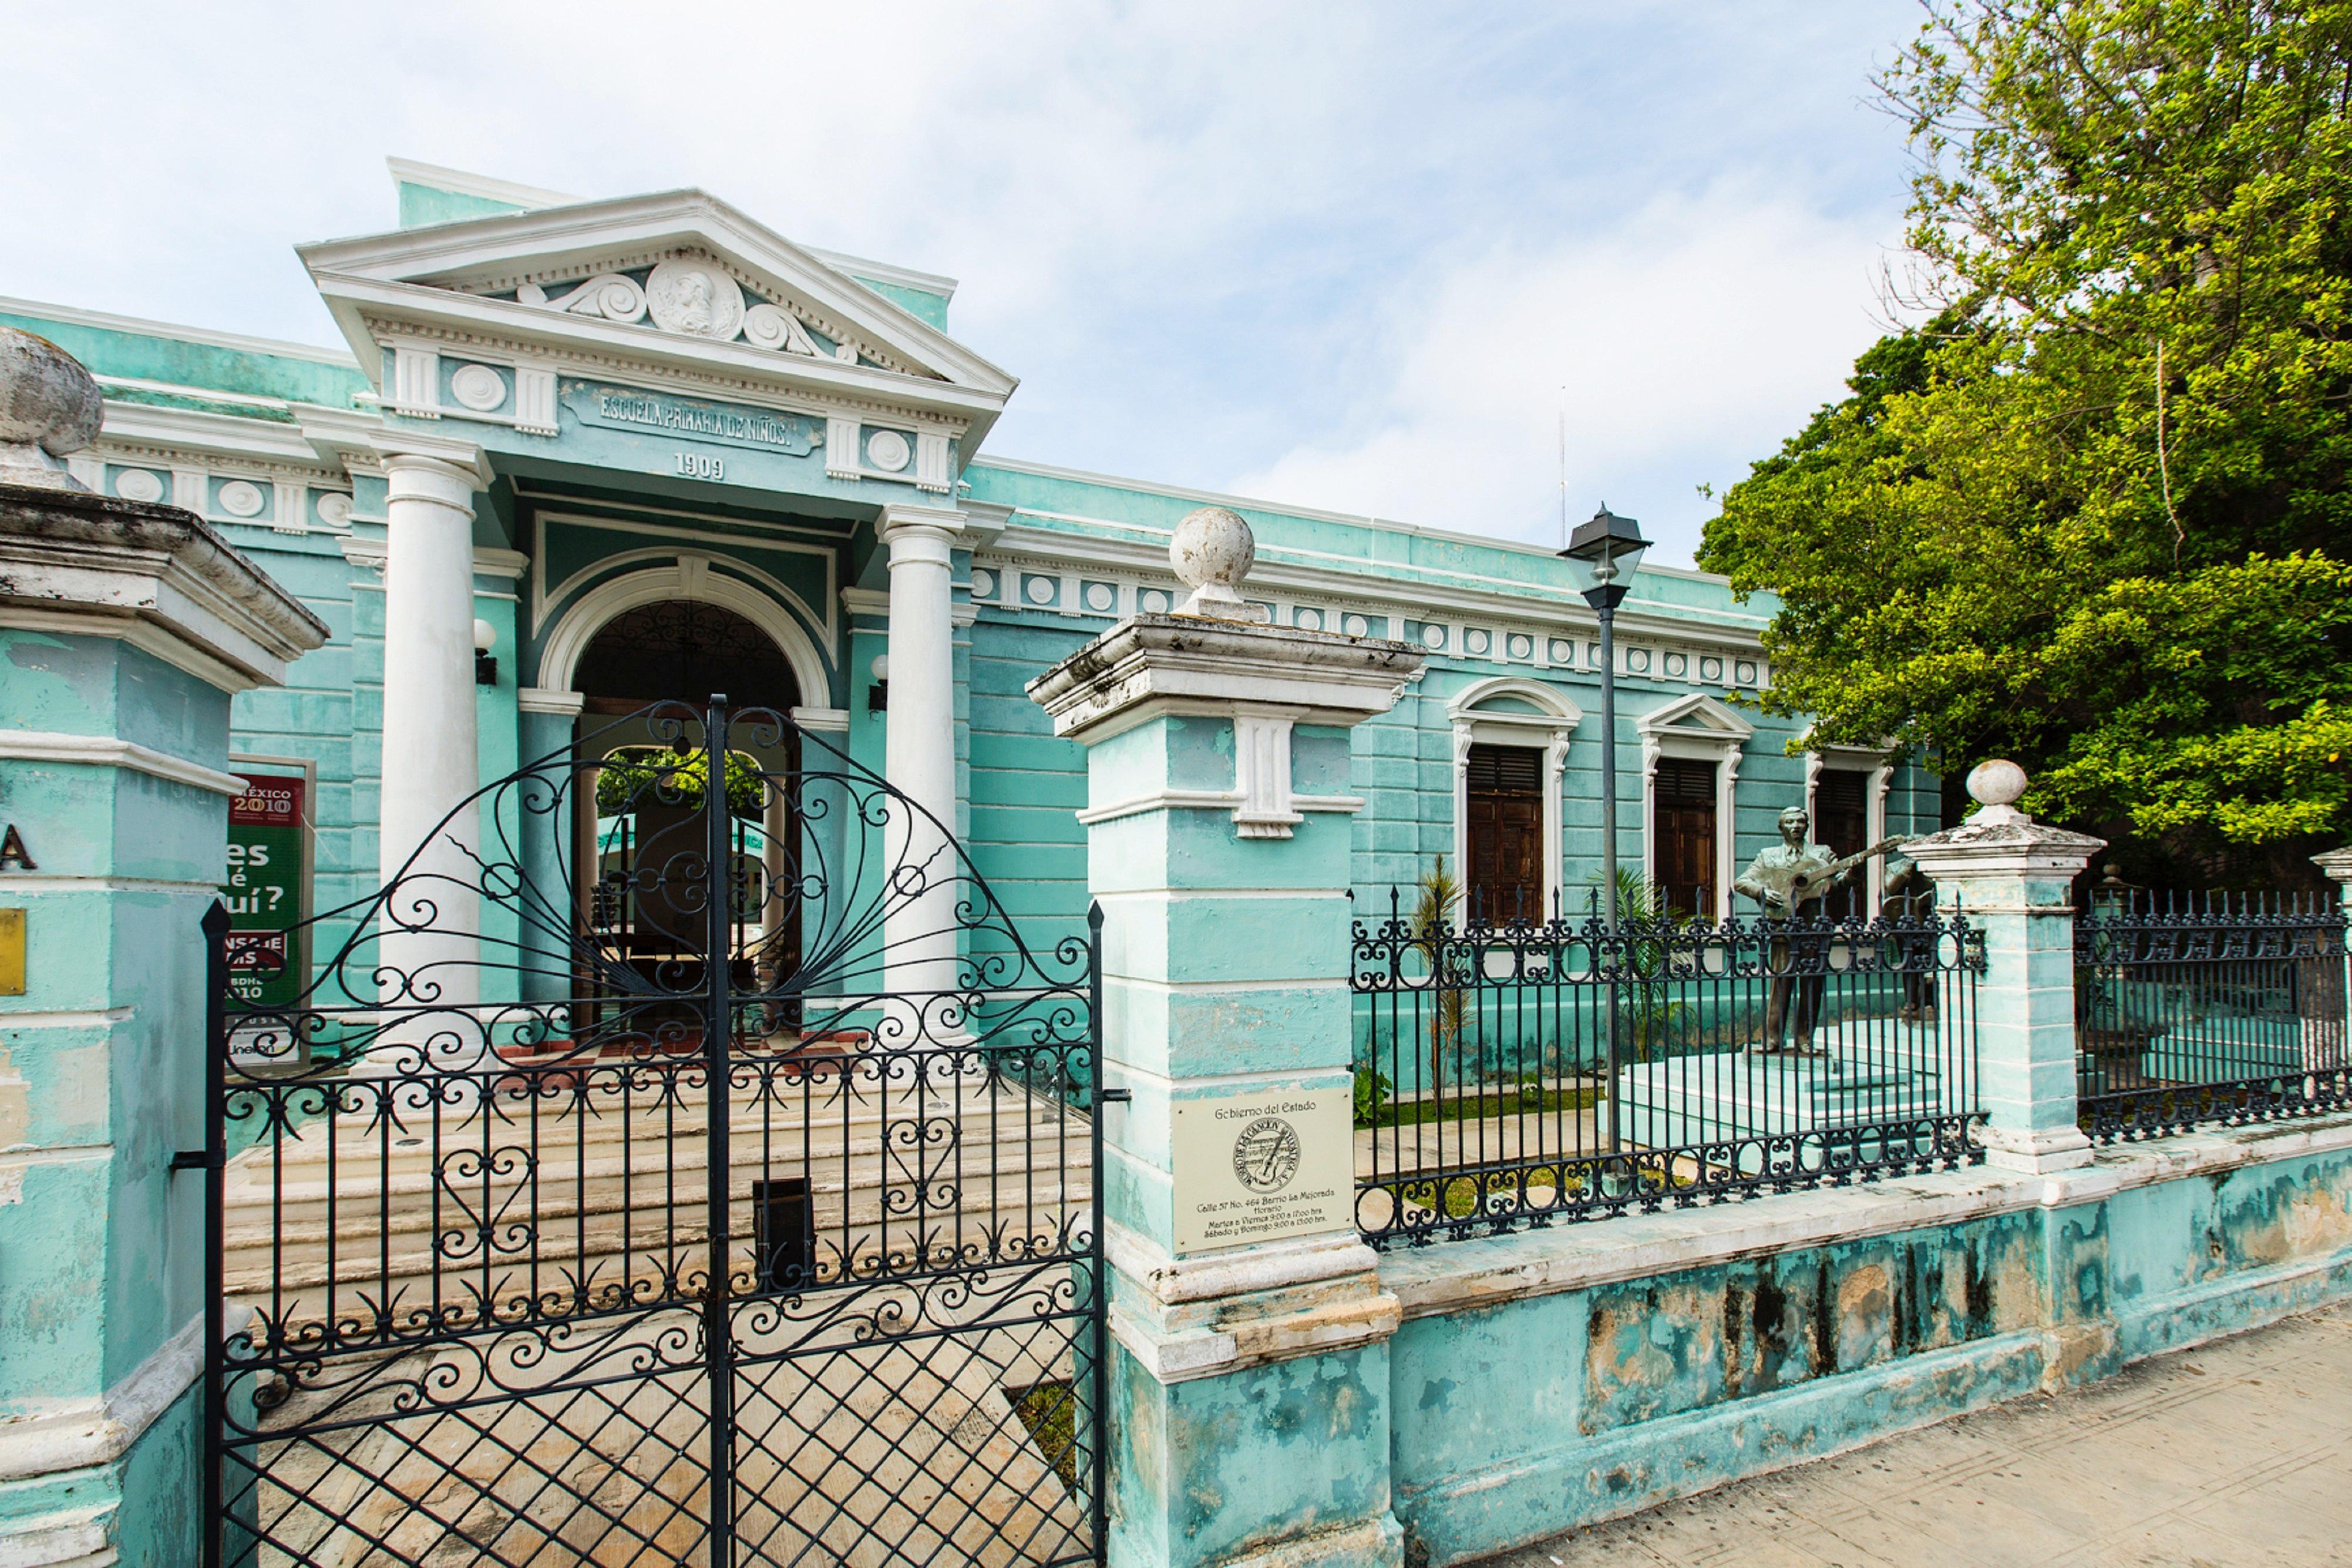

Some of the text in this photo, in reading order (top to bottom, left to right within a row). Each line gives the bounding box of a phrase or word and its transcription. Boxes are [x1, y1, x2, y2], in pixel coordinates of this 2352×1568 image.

[601, 396, 663, 426] ESCUELA
[664, 408, 724, 436] PRIMARIA
[727, 416, 743, 439] DE
[675, 452, 724, 480] 1909
[235, 798, 291, 813] 2010
[227, 843, 269, 866] es
[227, 886, 284, 914] uí?
[1215, 1101, 1316, 1119] Gobierno del Estado
[1197, 1203, 1217, 1213] Calle
[1230, 1200, 1243, 1209] No.
[1262, 1195, 1287, 1205] Barrio
[1300, 1188, 1334, 1200] Mejorada
[1254, 1205, 1281, 1214] Horario
[1208, 1220, 1233, 1229] Martes
[1242, 1216, 1268, 1224] Viernes
[1270, 1212, 1285, 1222] 9:00
[1240, 1224, 1273, 1234] Domingo
[1273, 1221, 1289, 1230] 9:00
